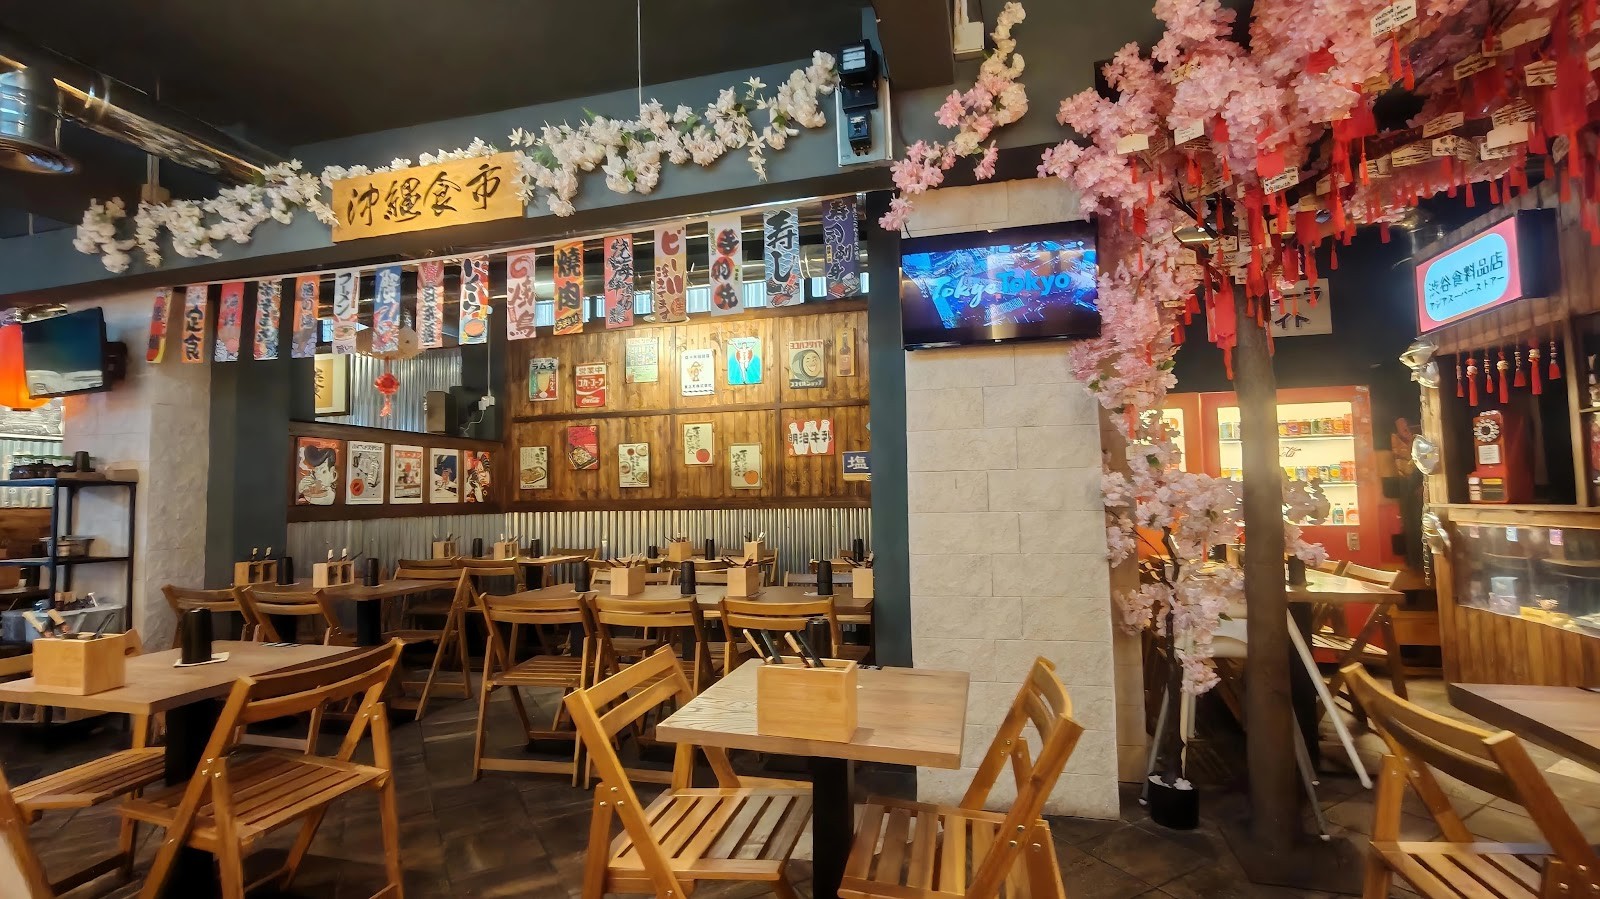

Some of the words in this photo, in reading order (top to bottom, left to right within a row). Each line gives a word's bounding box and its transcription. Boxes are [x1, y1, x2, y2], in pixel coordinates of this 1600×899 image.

[766, 210, 797, 282] 寿し
[932, 276, 998, 308] Tokyo
[996, 270, 1072, 296] Tokyo
[183, 305, 204, 361] 定食
[531, 361, 556, 371] ラムネ
[788, 430, 833, 445] 明治牛乳
[846, 455, 870, 470] 塩
